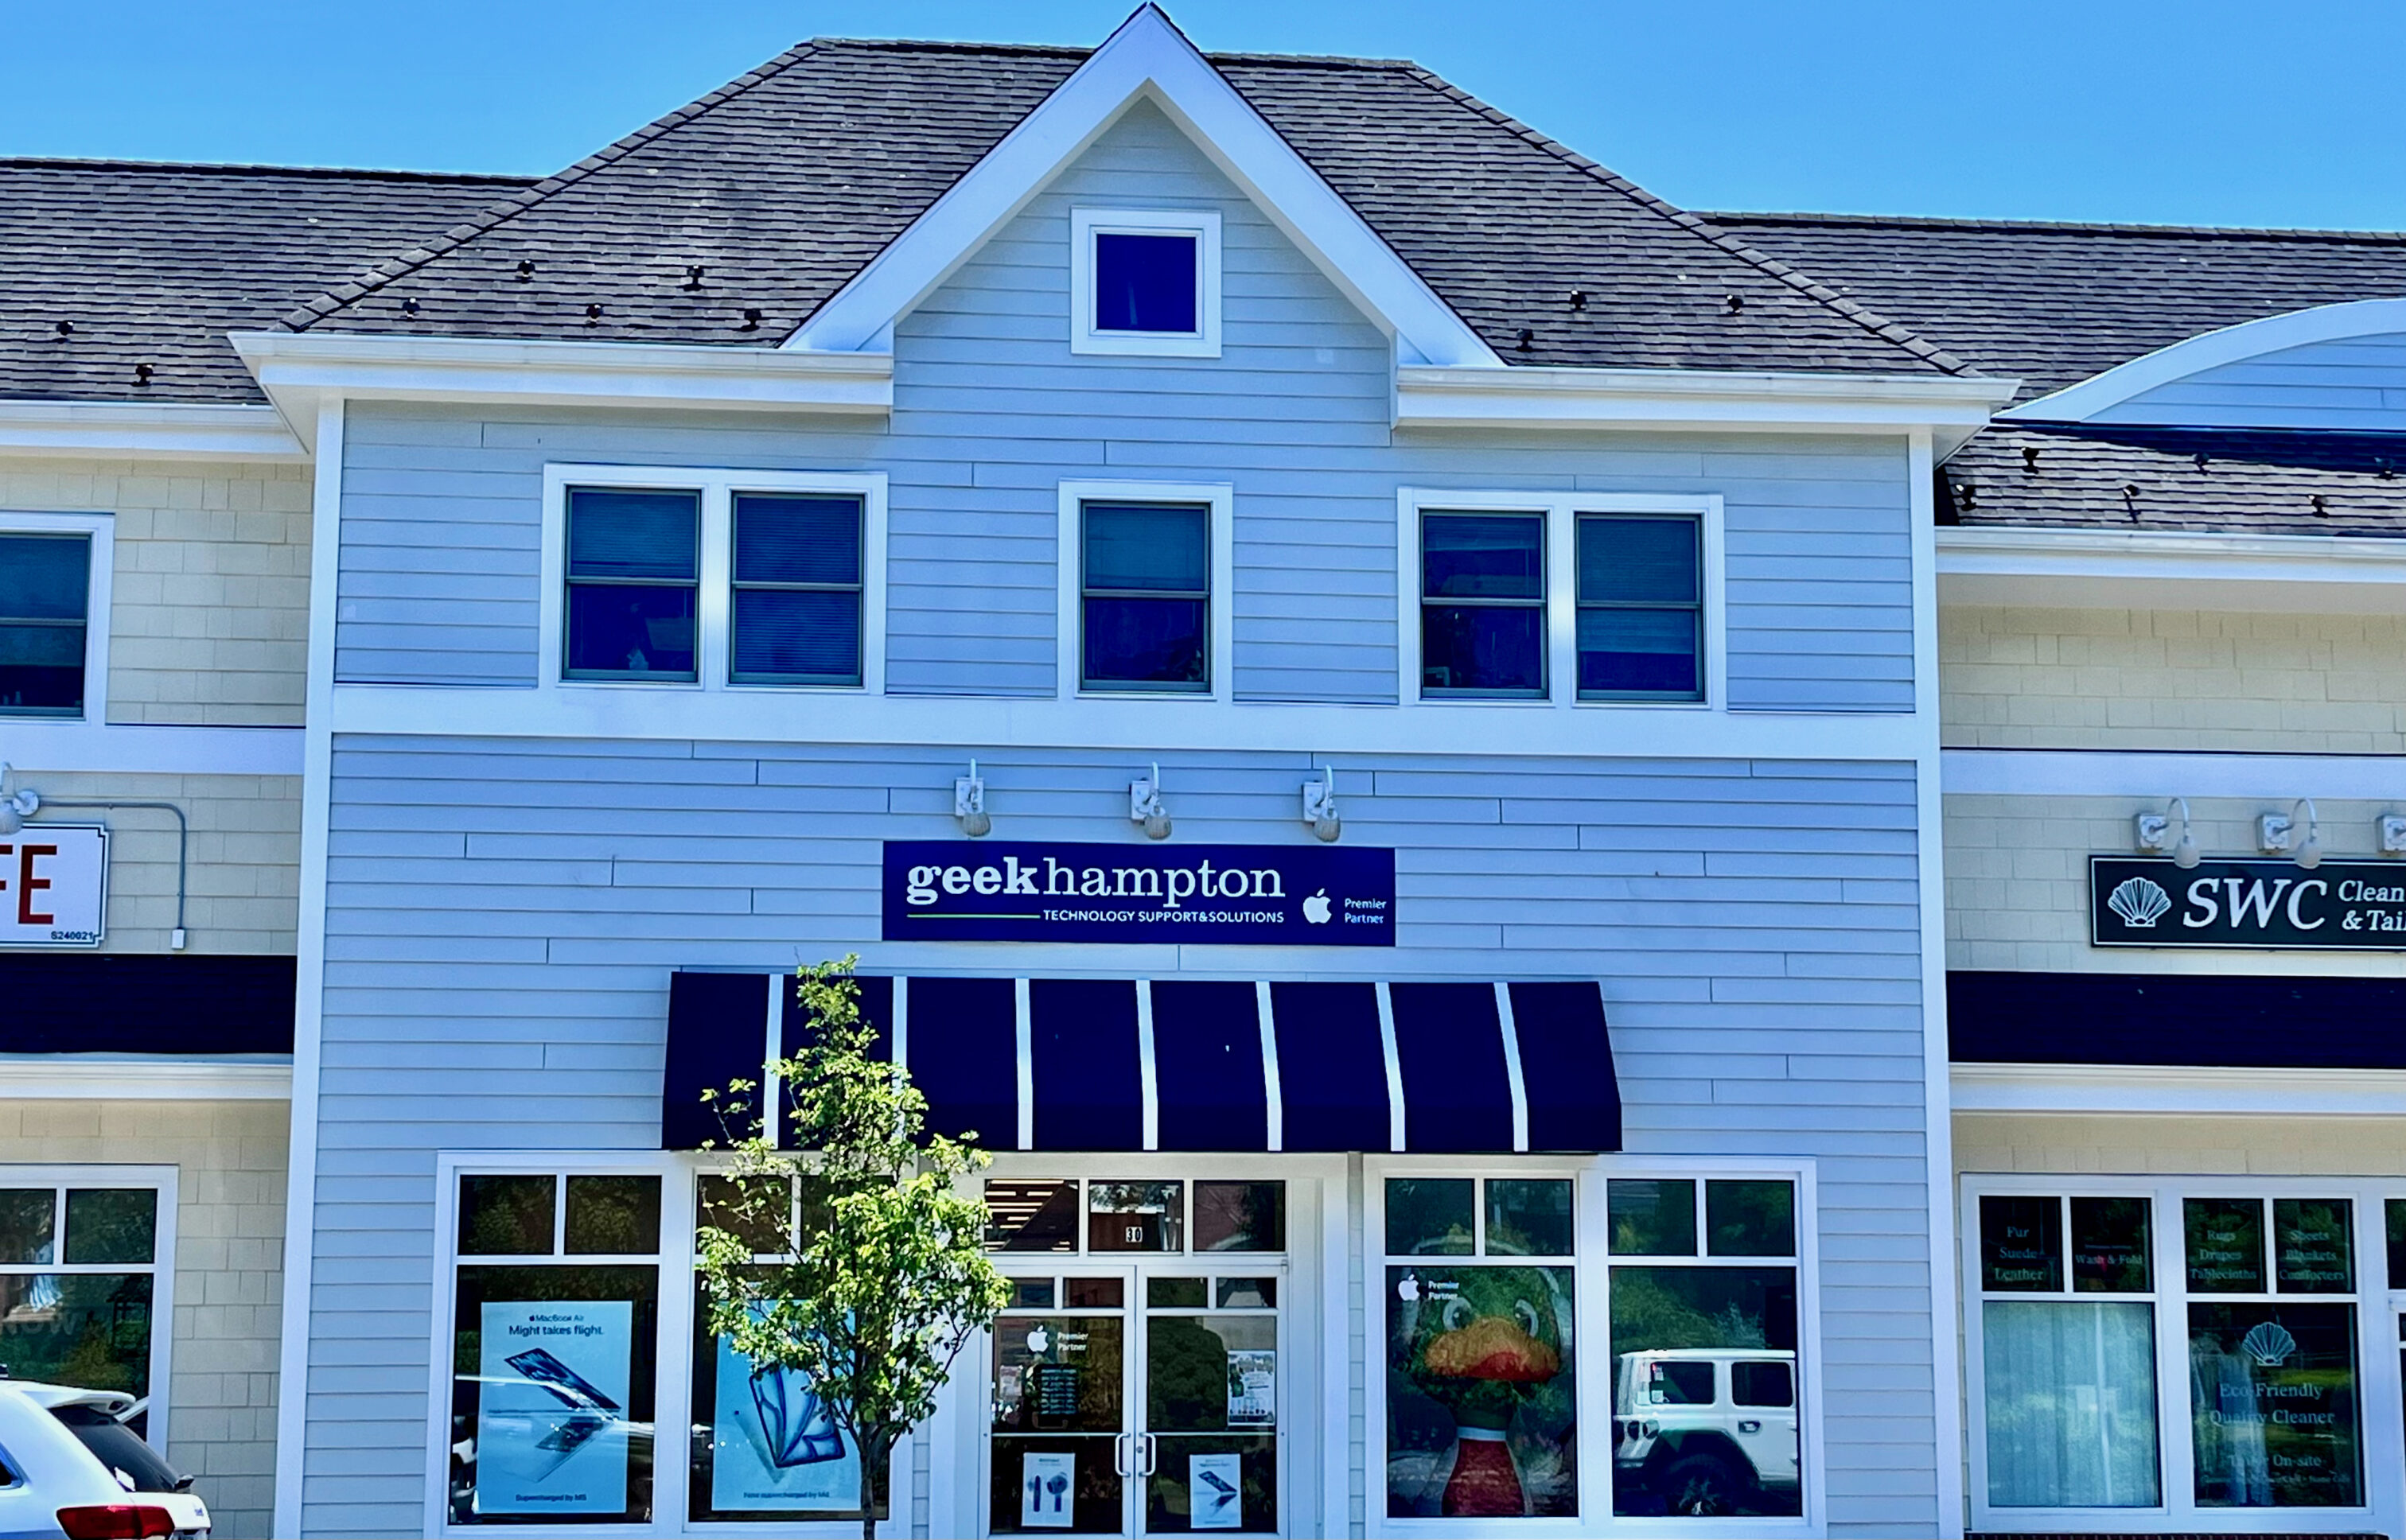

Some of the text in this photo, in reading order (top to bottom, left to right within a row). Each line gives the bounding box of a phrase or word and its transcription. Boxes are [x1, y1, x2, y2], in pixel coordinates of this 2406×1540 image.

[907, 857, 1286, 908] geekhampton
[2338, 879, 2405, 902] Clean
[1345, 898, 1387, 909] Premier
[2183, 878, 2327, 930] SWC
[1043, 909, 1135, 921] TECHNOLOGY
[1345, 912, 1384, 924] Partner
[2342, 910, 2406, 931] & Tai
[1127, 1227, 1141, 1242] 30
[2007, 1226, 2030, 1238] Fur
[1999, 1247, 2038, 1259] Suede
[2199, 1249, 2242, 1262] Drapes
[1994, 1267, 2044, 1281] Leather
[1428, 1280, 1459, 1289] Premier
[1428, 1292, 1458, 1301] Partner
[509, 1325, 540, 1337] Might
[543, 1325, 572, 1336] takes
[1057, 1332, 1088, 1341] Premier
[1057, 1343, 1087, 1351] Partner
[2219, 1382, 2323, 1400] Eco-Friendly
[2272, 1410, 2335, 1425] Cleaner
